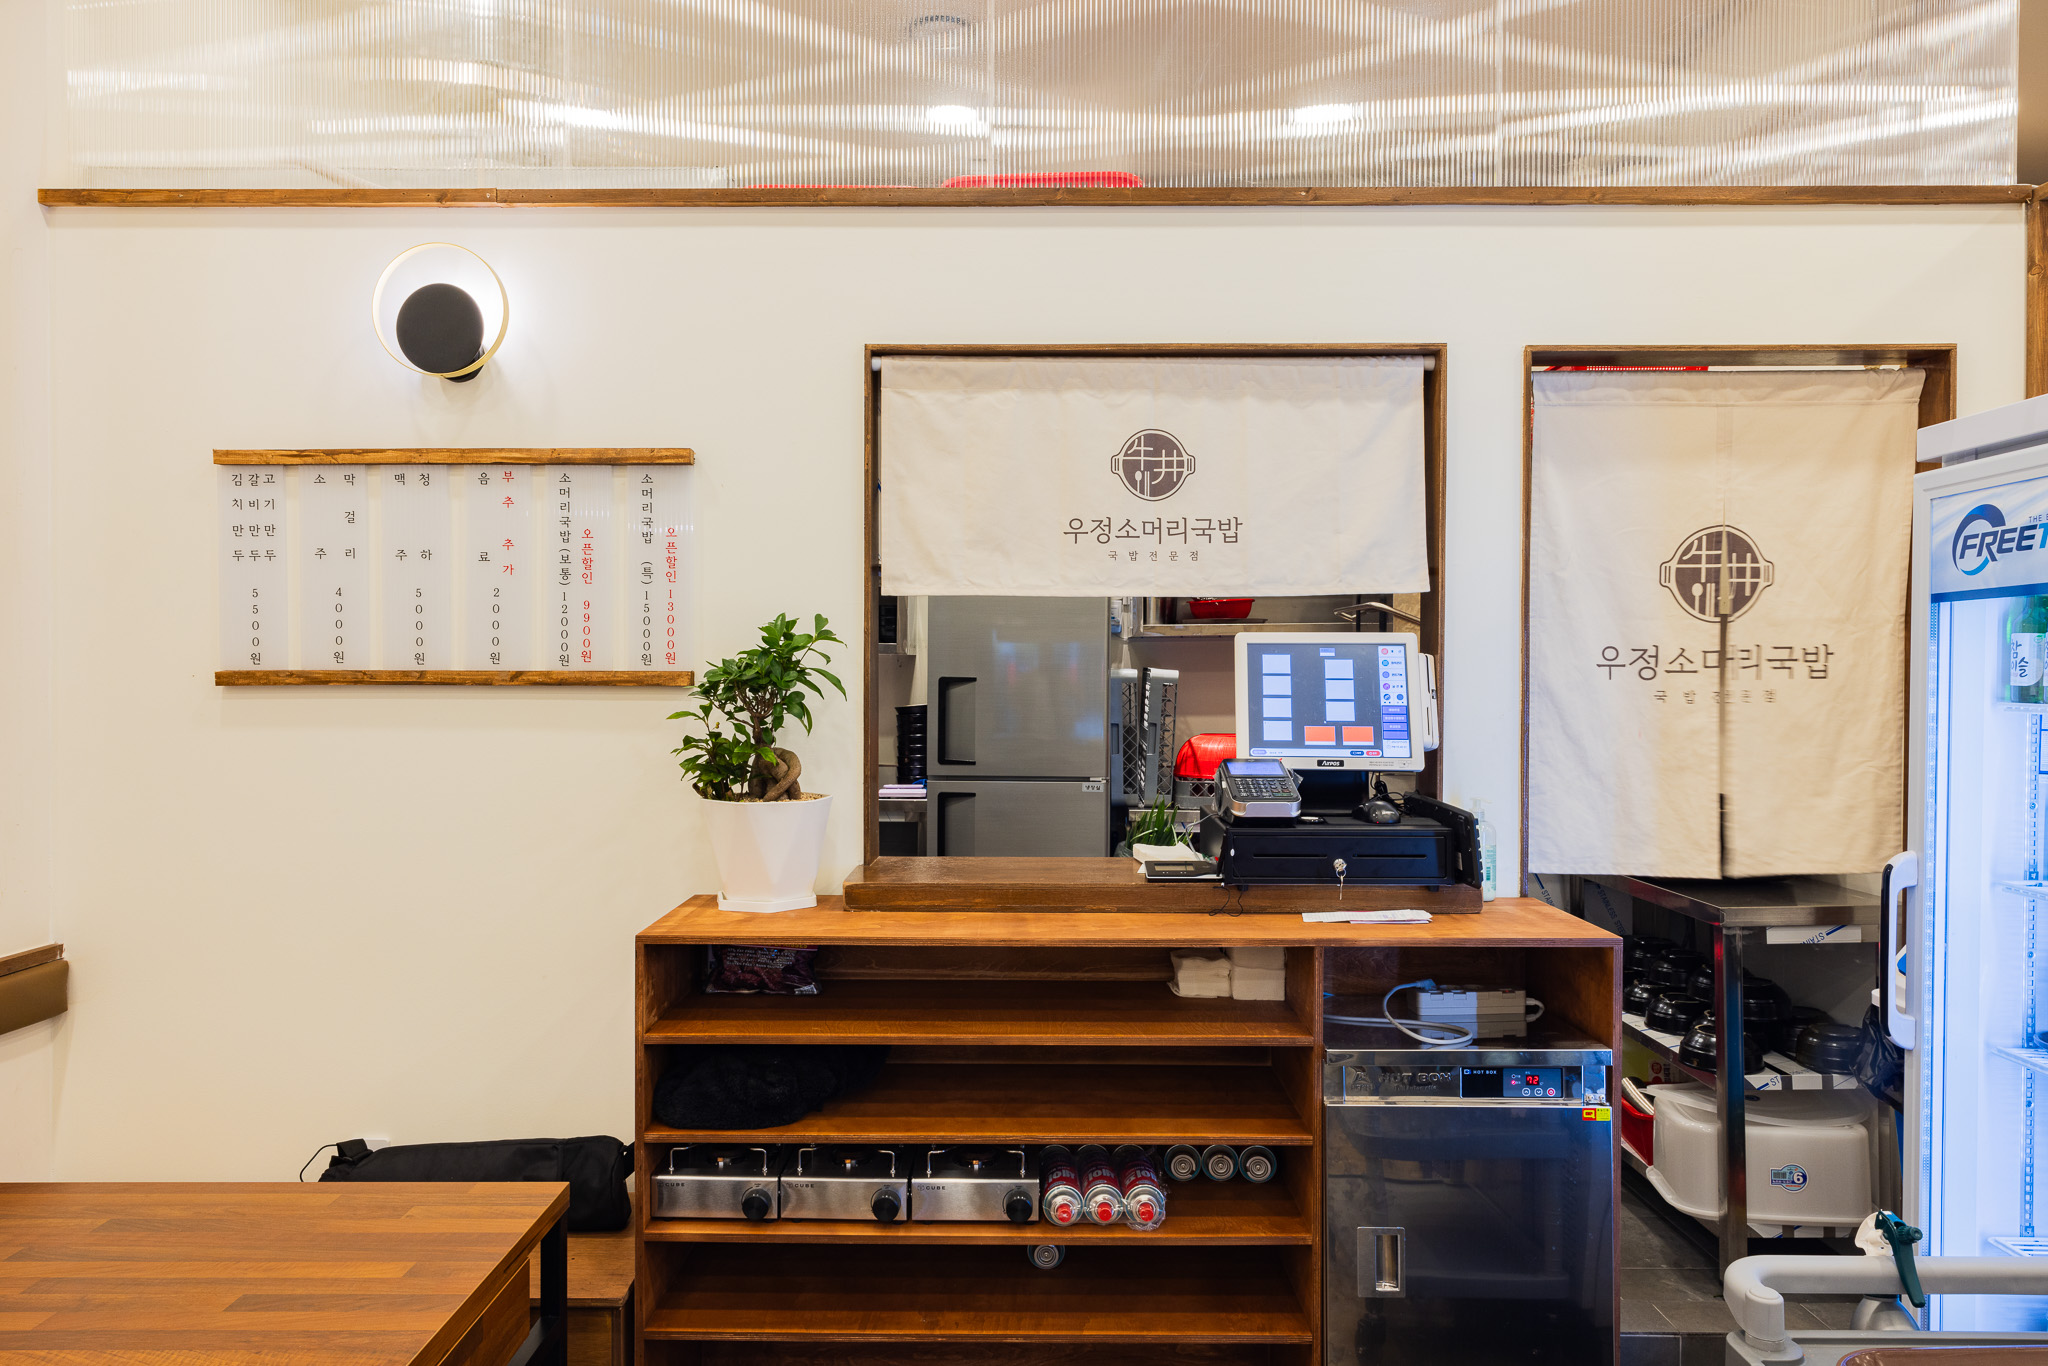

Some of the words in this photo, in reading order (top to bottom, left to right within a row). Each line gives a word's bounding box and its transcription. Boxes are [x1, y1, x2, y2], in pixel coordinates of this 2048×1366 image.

[641, 473, 654, 544] 소머리국밥
[1062, 516, 1244, 545] 우정소머리국밥
[2028, 514, 2043, 523] THE
[581, 528, 594, 585] 오픈할인
[665, 527, 678, 584] 오픈할인
[1107, 550, 1199, 562] 국밥전문점
[249, 588, 261, 666] 5500원
[333, 587, 345, 664] 4000원
[413, 588, 425, 666] 5000원
[489, 587, 501, 665] 2000원
[580, 599, 592, 664] 9900원
[664, 588, 676, 665] 13000원
[1793, 1172, 1804, 1184] 6
